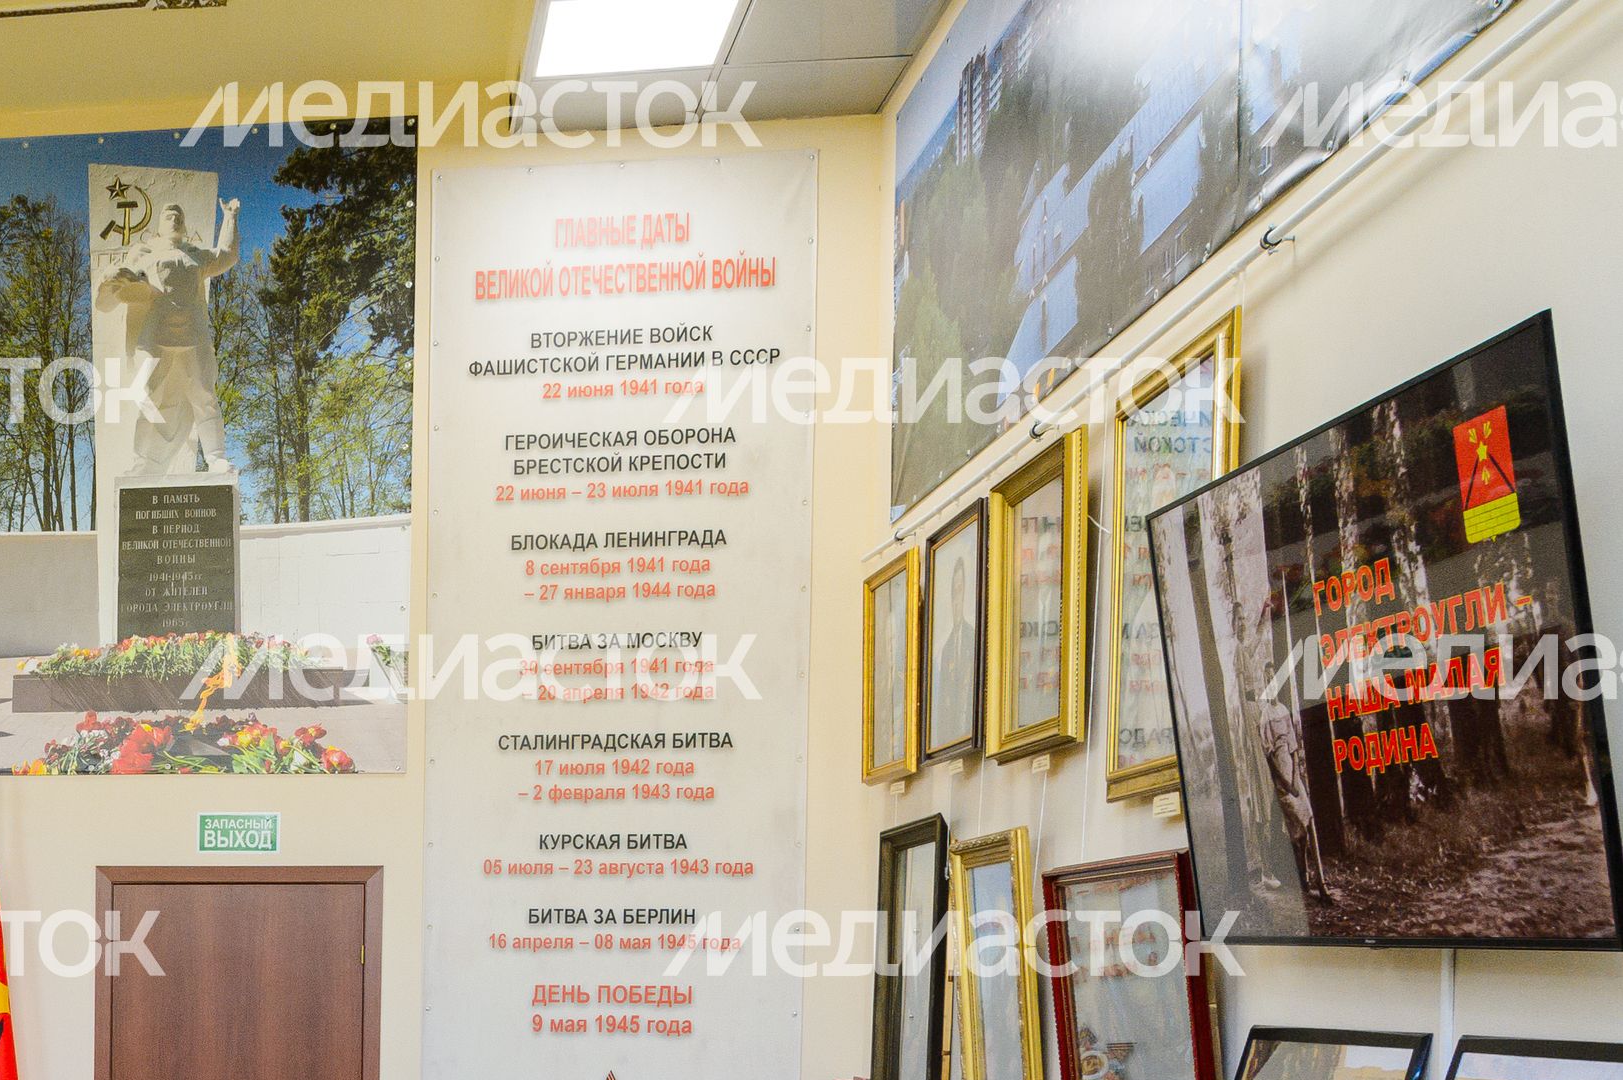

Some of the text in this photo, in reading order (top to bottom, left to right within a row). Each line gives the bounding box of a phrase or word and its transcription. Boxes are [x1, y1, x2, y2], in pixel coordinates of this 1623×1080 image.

[554, 212, 690, 249] ГЛАВНЫЕ ДАТЫ
[475, 249, 776, 300] ВЕЛИКОЙ ОТЕЧЕСТВЕННОЙ ВОЙНЫ
[530, 322, 713, 348] ВТОРЖЕНИЕ ВОЙСК
[468, 348, 781, 377] ФАШИСТСКОЙ ГЕРМАНИИ В СССР
[542, 379, 705, 399] 22 июня 1941 года
[505, 426, 736, 452] ГЕРОИЧЕСКАЯ ОБОРОНА
[513, 451, 726, 476] БРЕСТСКОЙ КРЕПОСТИ
[152, 494, 200, 504] В ПАМЯТЬ
[495, 485, 514, 502] 22
[520, 486, 567, 501] июня
[587, 482, 606, 499] 23
[611, 483, 659, 499] июля
[665, 479, 703, 496] 1941
[709, 480, 749, 497] года
[135, 508, 217, 520] ПОГИБШИХ ВОИНОВ
[152, 524, 200, 534] В ПЕРИОД
[510, 529, 727, 552] БЛОКАДА ЛЕНИНГРАДА
[525, 557, 711, 577] 8 сентября 1941 года
[539, 584, 558, 600] 27
[563, 586, 626, 603] января
[631, 582, 671, 598] 1944
[677, 583, 716, 599] года
[1312, 557, 1396, 617] ГОРОД
[1320, 581, 1508, 669] ЭЛЕКТРОУГЛИ
[532, 632, 703, 650] БИТВА ЗА МОСКВУ
[543, 658, 625, 677] сентября
[630, 658, 668, 674] 1941
[674, 659, 714, 676] года
[562, 686, 625, 704] апреля
[631, 683, 670, 699] 1942
[674, 684, 714, 701] года
[1325, 646, 1506, 722] НАША МАЛАЯ
[498, 732, 733, 752] СТАЛИНГРАДСКАЯ БИТВА
[1333, 722, 1438, 776] РОДИНА
[535, 759, 695, 776] 17 июля 1942 года
[533, 785, 542, 801] 2
[548, 784, 626, 803] февраля
[632, 783, 671, 800] 1943
[676, 785, 715, 801] года
[204, 817, 272, 829] ЗАПАСНЫЙ
[204, 830, 272, 849] ВЫХОД
[539, 833, 688, 850] КУРСКАЯ БИТВА
[483, 859, 502, 875] 05
[508, 861, 554, 876] июля
[574, 859, 593, 875] 23
[599, 862, 664, 878] августа
[671, 858, 709, 875] 1943
[715, 860, 754, 876] года
[528, 909, 696, 925] БИТВА ЗА БЕРЛИН
[489, 933, 507, 949] 16
[512, 936, 574, 953] апреля
[594, 934, 613, 950] 08
[619, 936, 651, 950] мая
[658, 934, 696, 950] 1945
[702, 936, 742, 952] года
[532, 985, 693, 1007] ДЕНЬ ПОБЕДЫ
[531, 1014, 693, 1036] 9 мая 1945 года
